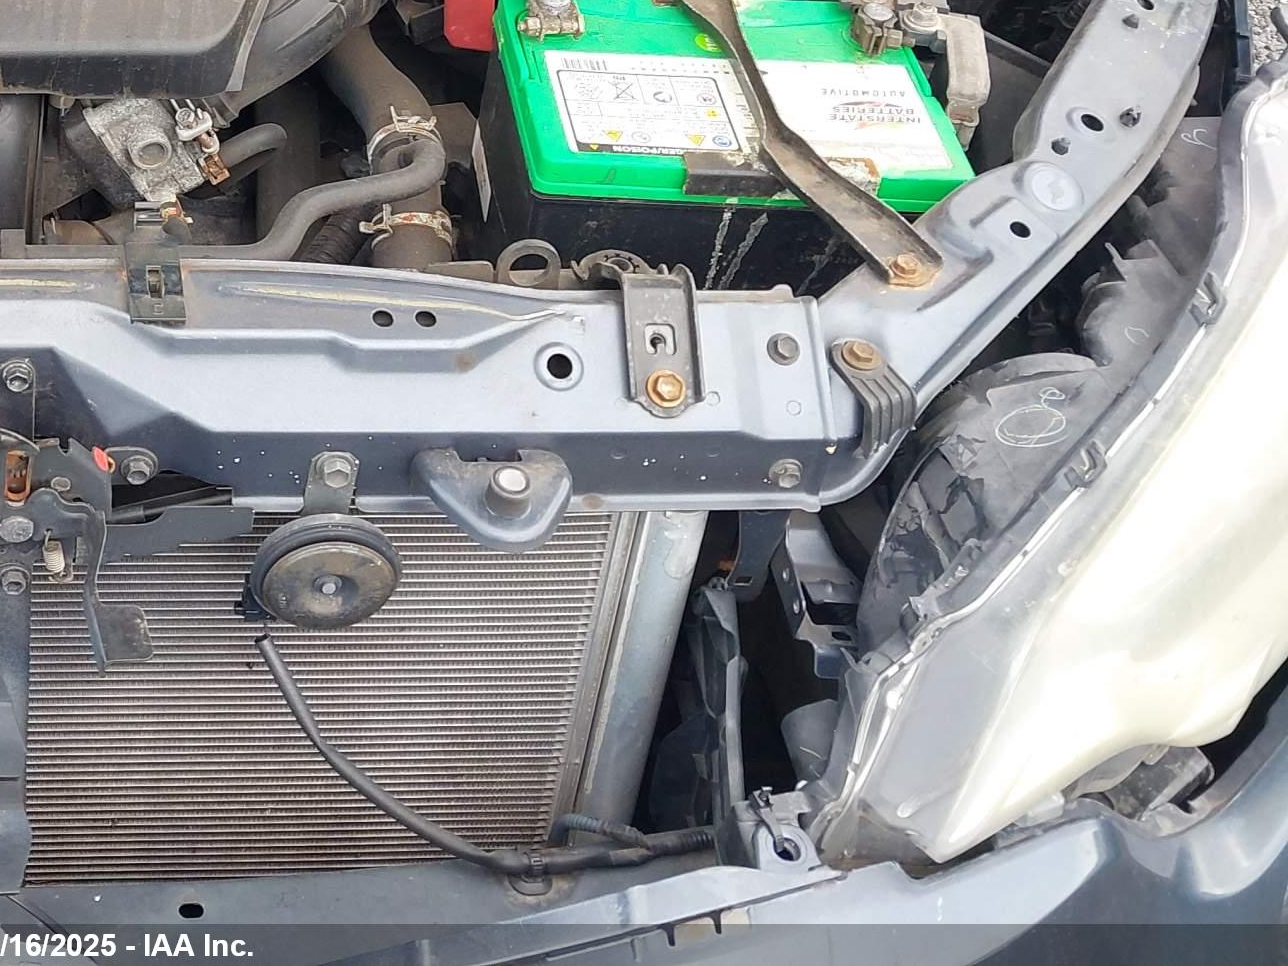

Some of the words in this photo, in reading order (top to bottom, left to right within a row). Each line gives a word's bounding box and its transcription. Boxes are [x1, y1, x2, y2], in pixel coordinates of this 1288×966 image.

[819, 88, 906, 98] AUTOMOTIVE
[831, 106, 915, 116] BATTERIES
[827, 114, 921, 124] INTERSTATE
[612, 144, 685, 155] GER/POISON
